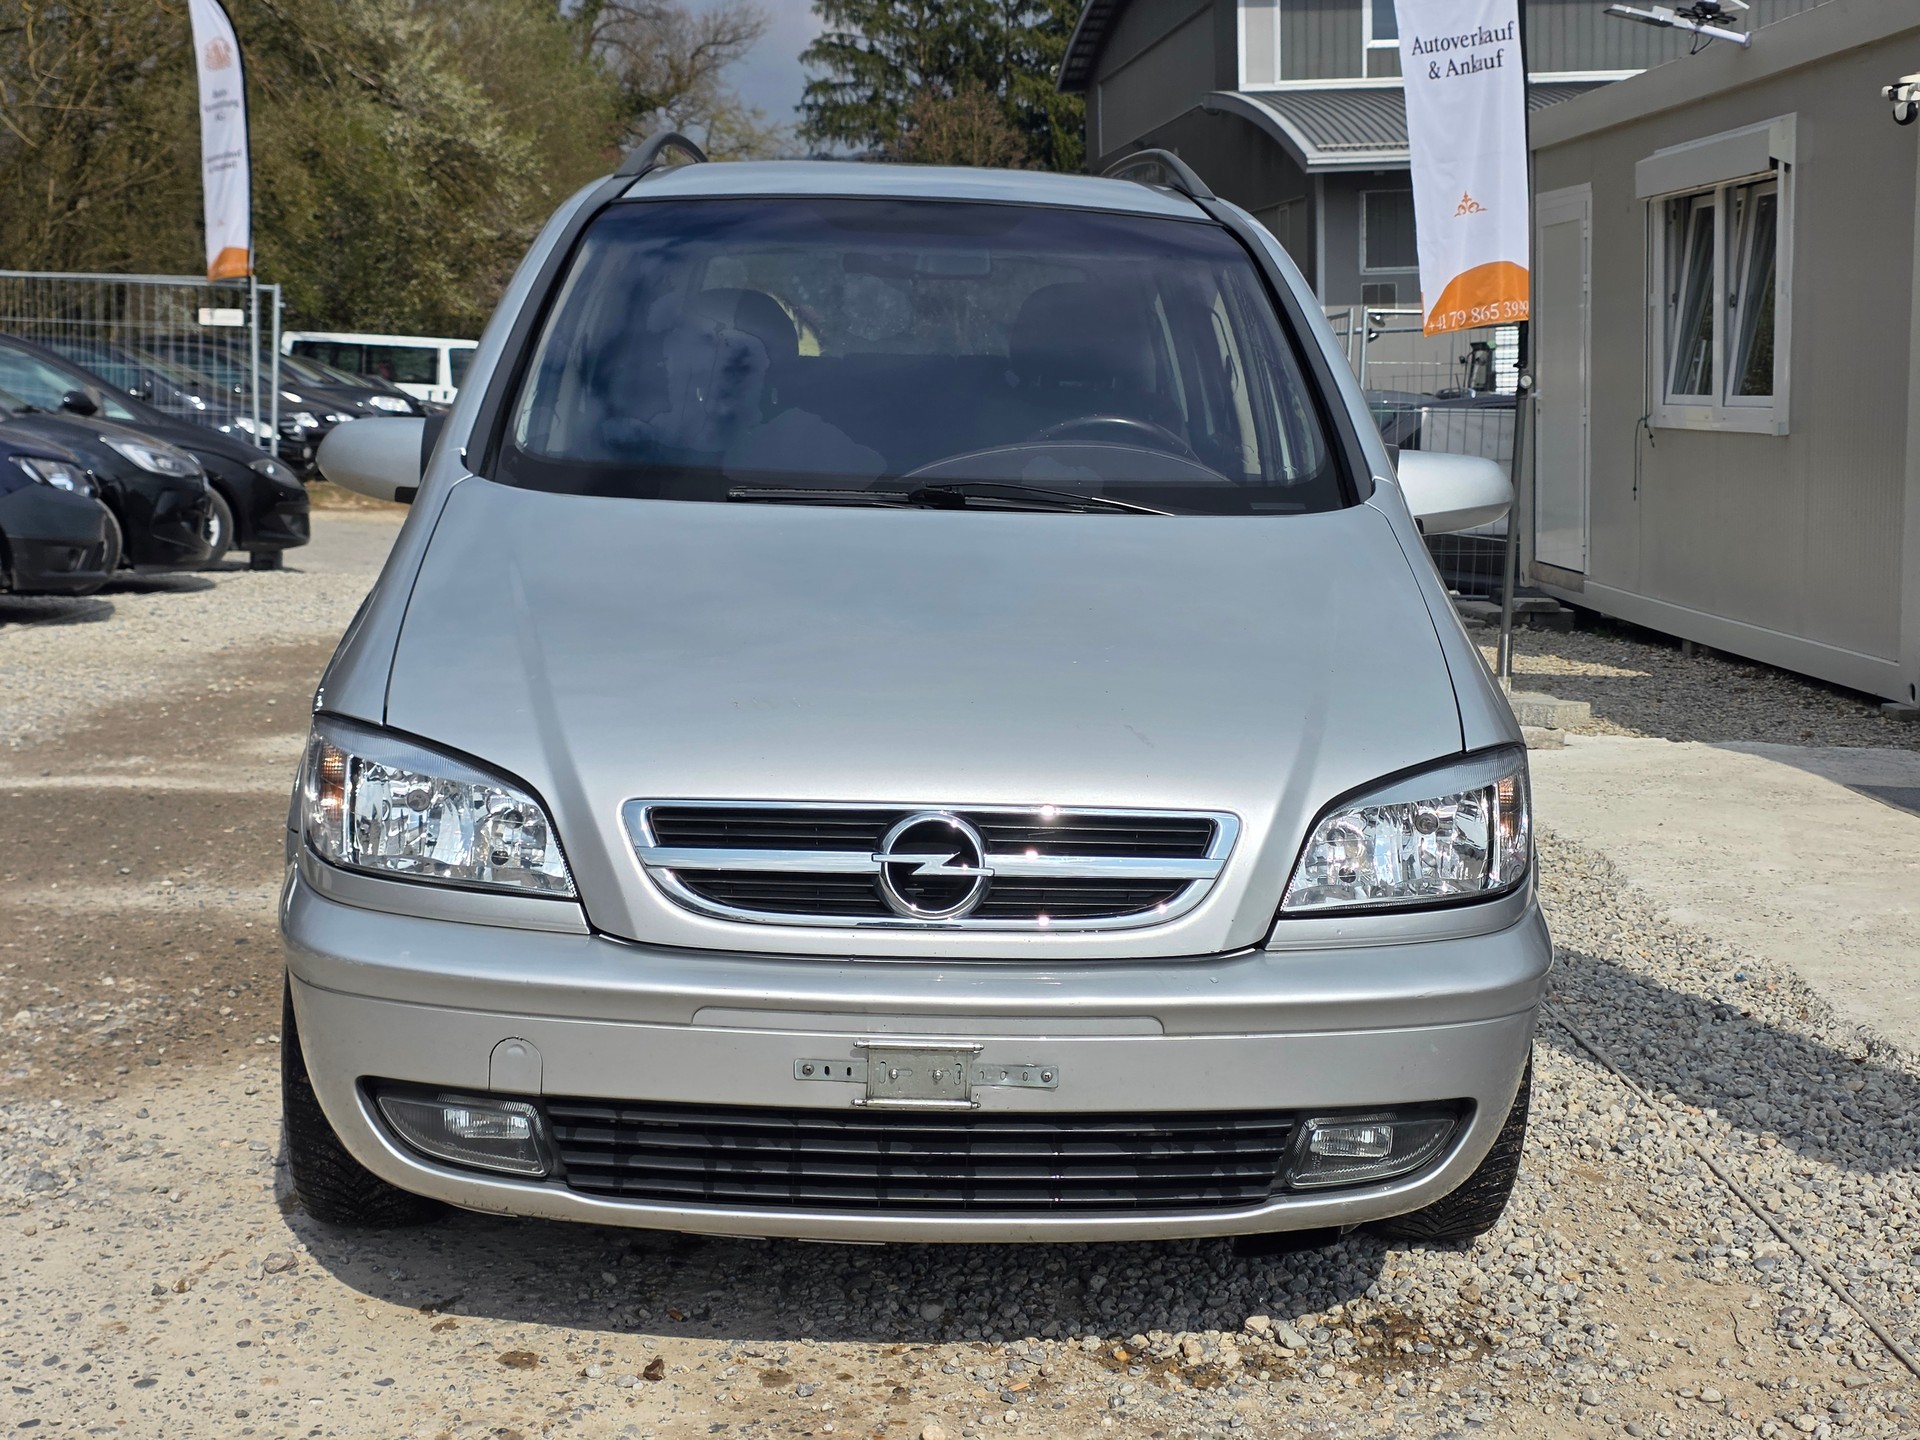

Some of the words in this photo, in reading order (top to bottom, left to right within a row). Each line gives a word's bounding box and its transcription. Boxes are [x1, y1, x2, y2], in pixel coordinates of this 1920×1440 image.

[1428, 60, 1441, 80] &
[1449, 310, 1467, 327] 79
[1471, 302, 1501, 323] 865
